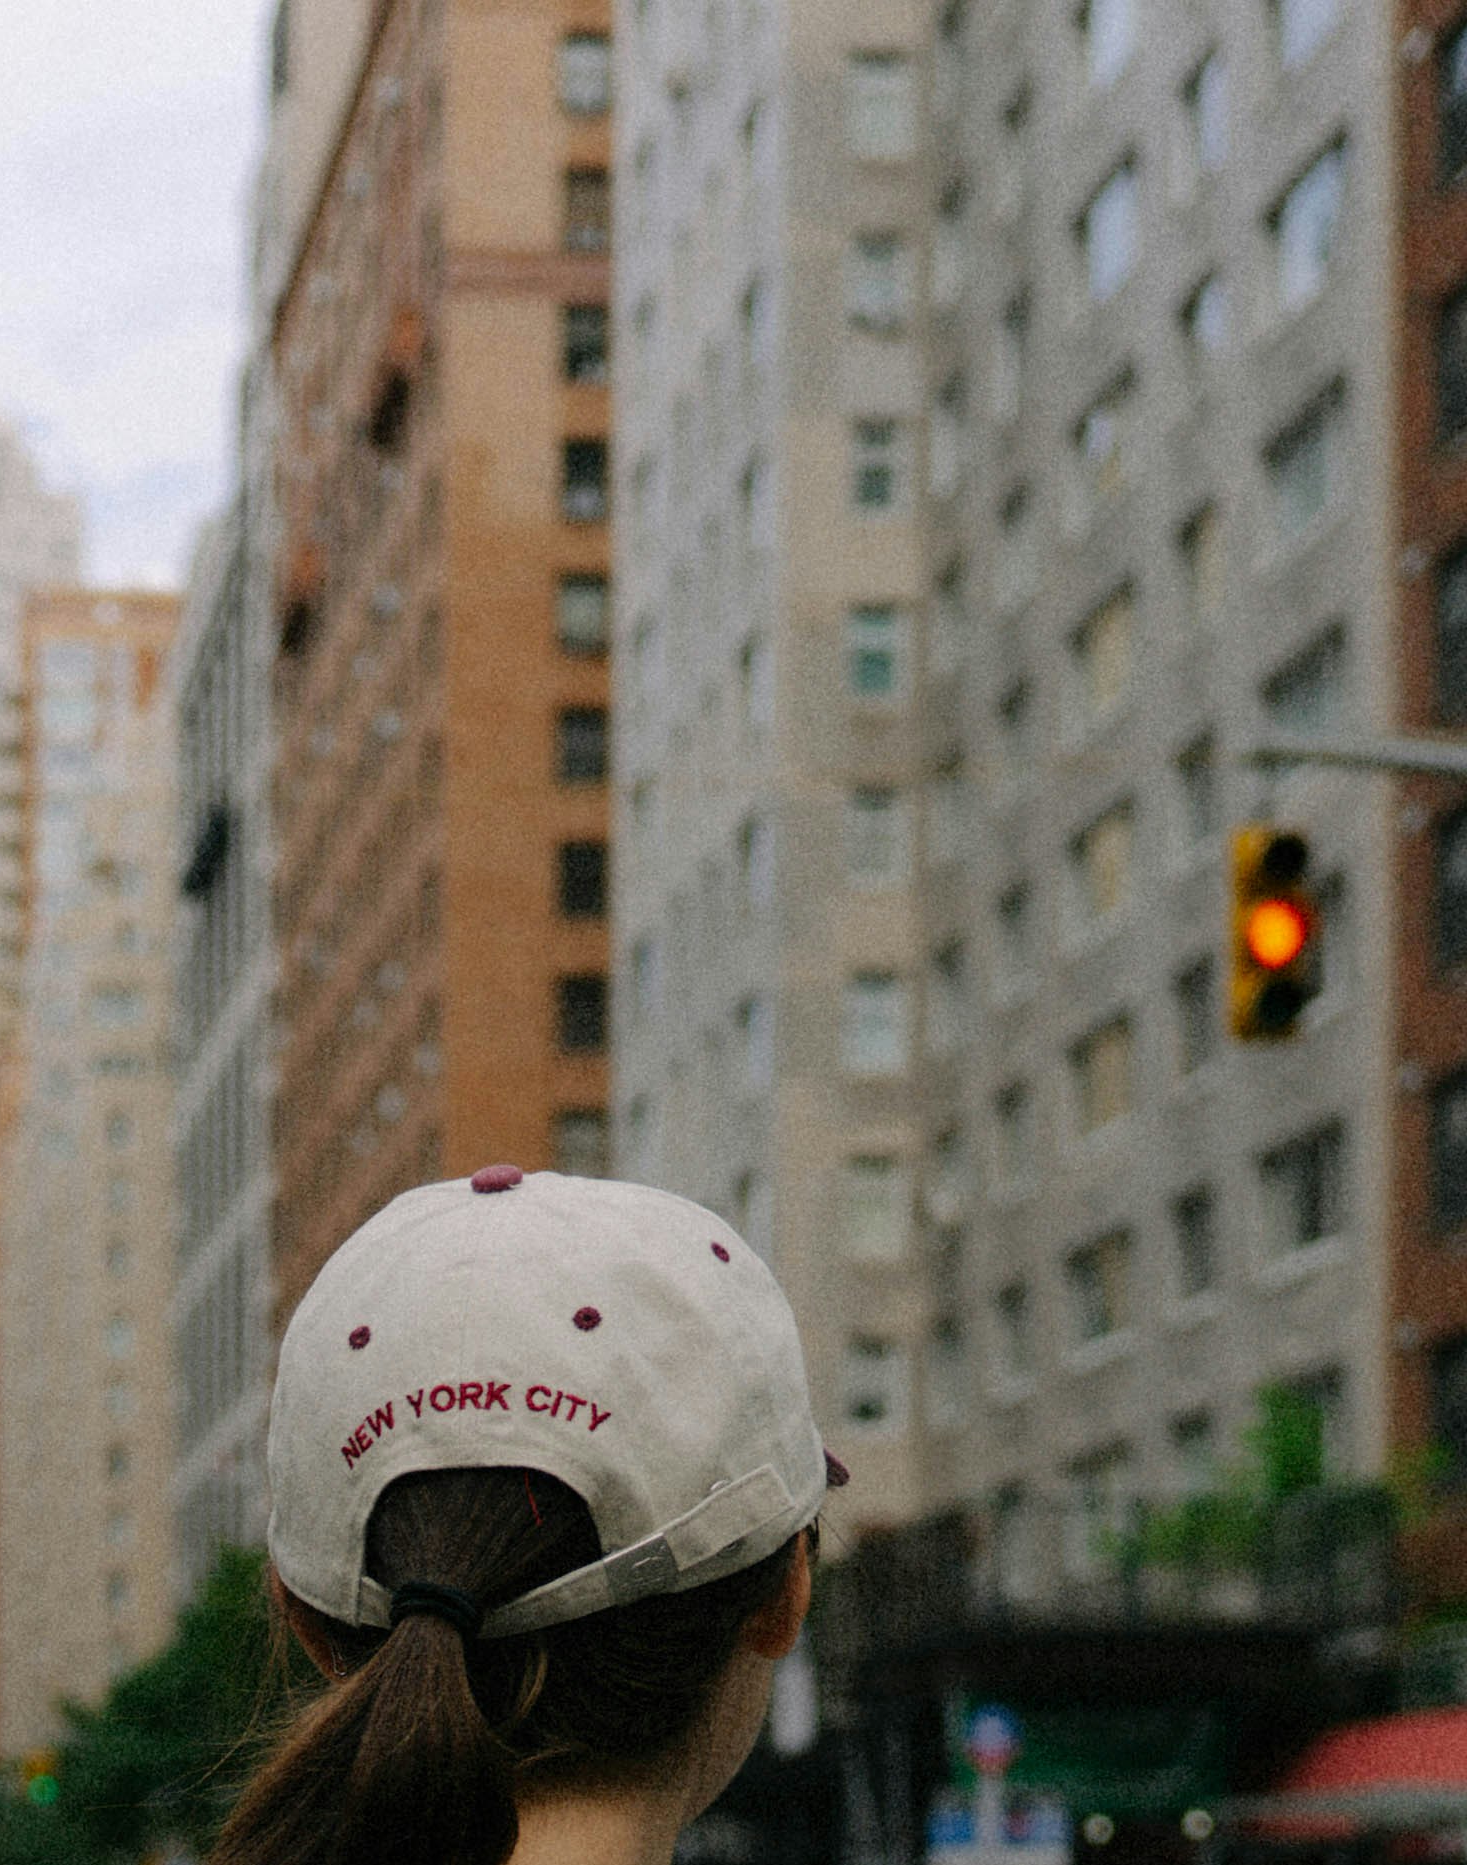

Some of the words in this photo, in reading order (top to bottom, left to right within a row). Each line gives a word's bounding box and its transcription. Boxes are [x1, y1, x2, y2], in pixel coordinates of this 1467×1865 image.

[341, 1402, 394, 1470] NEW
[406, 1381, 511, 1418] YORK
[525, 1385, 611, 1431] CITY
